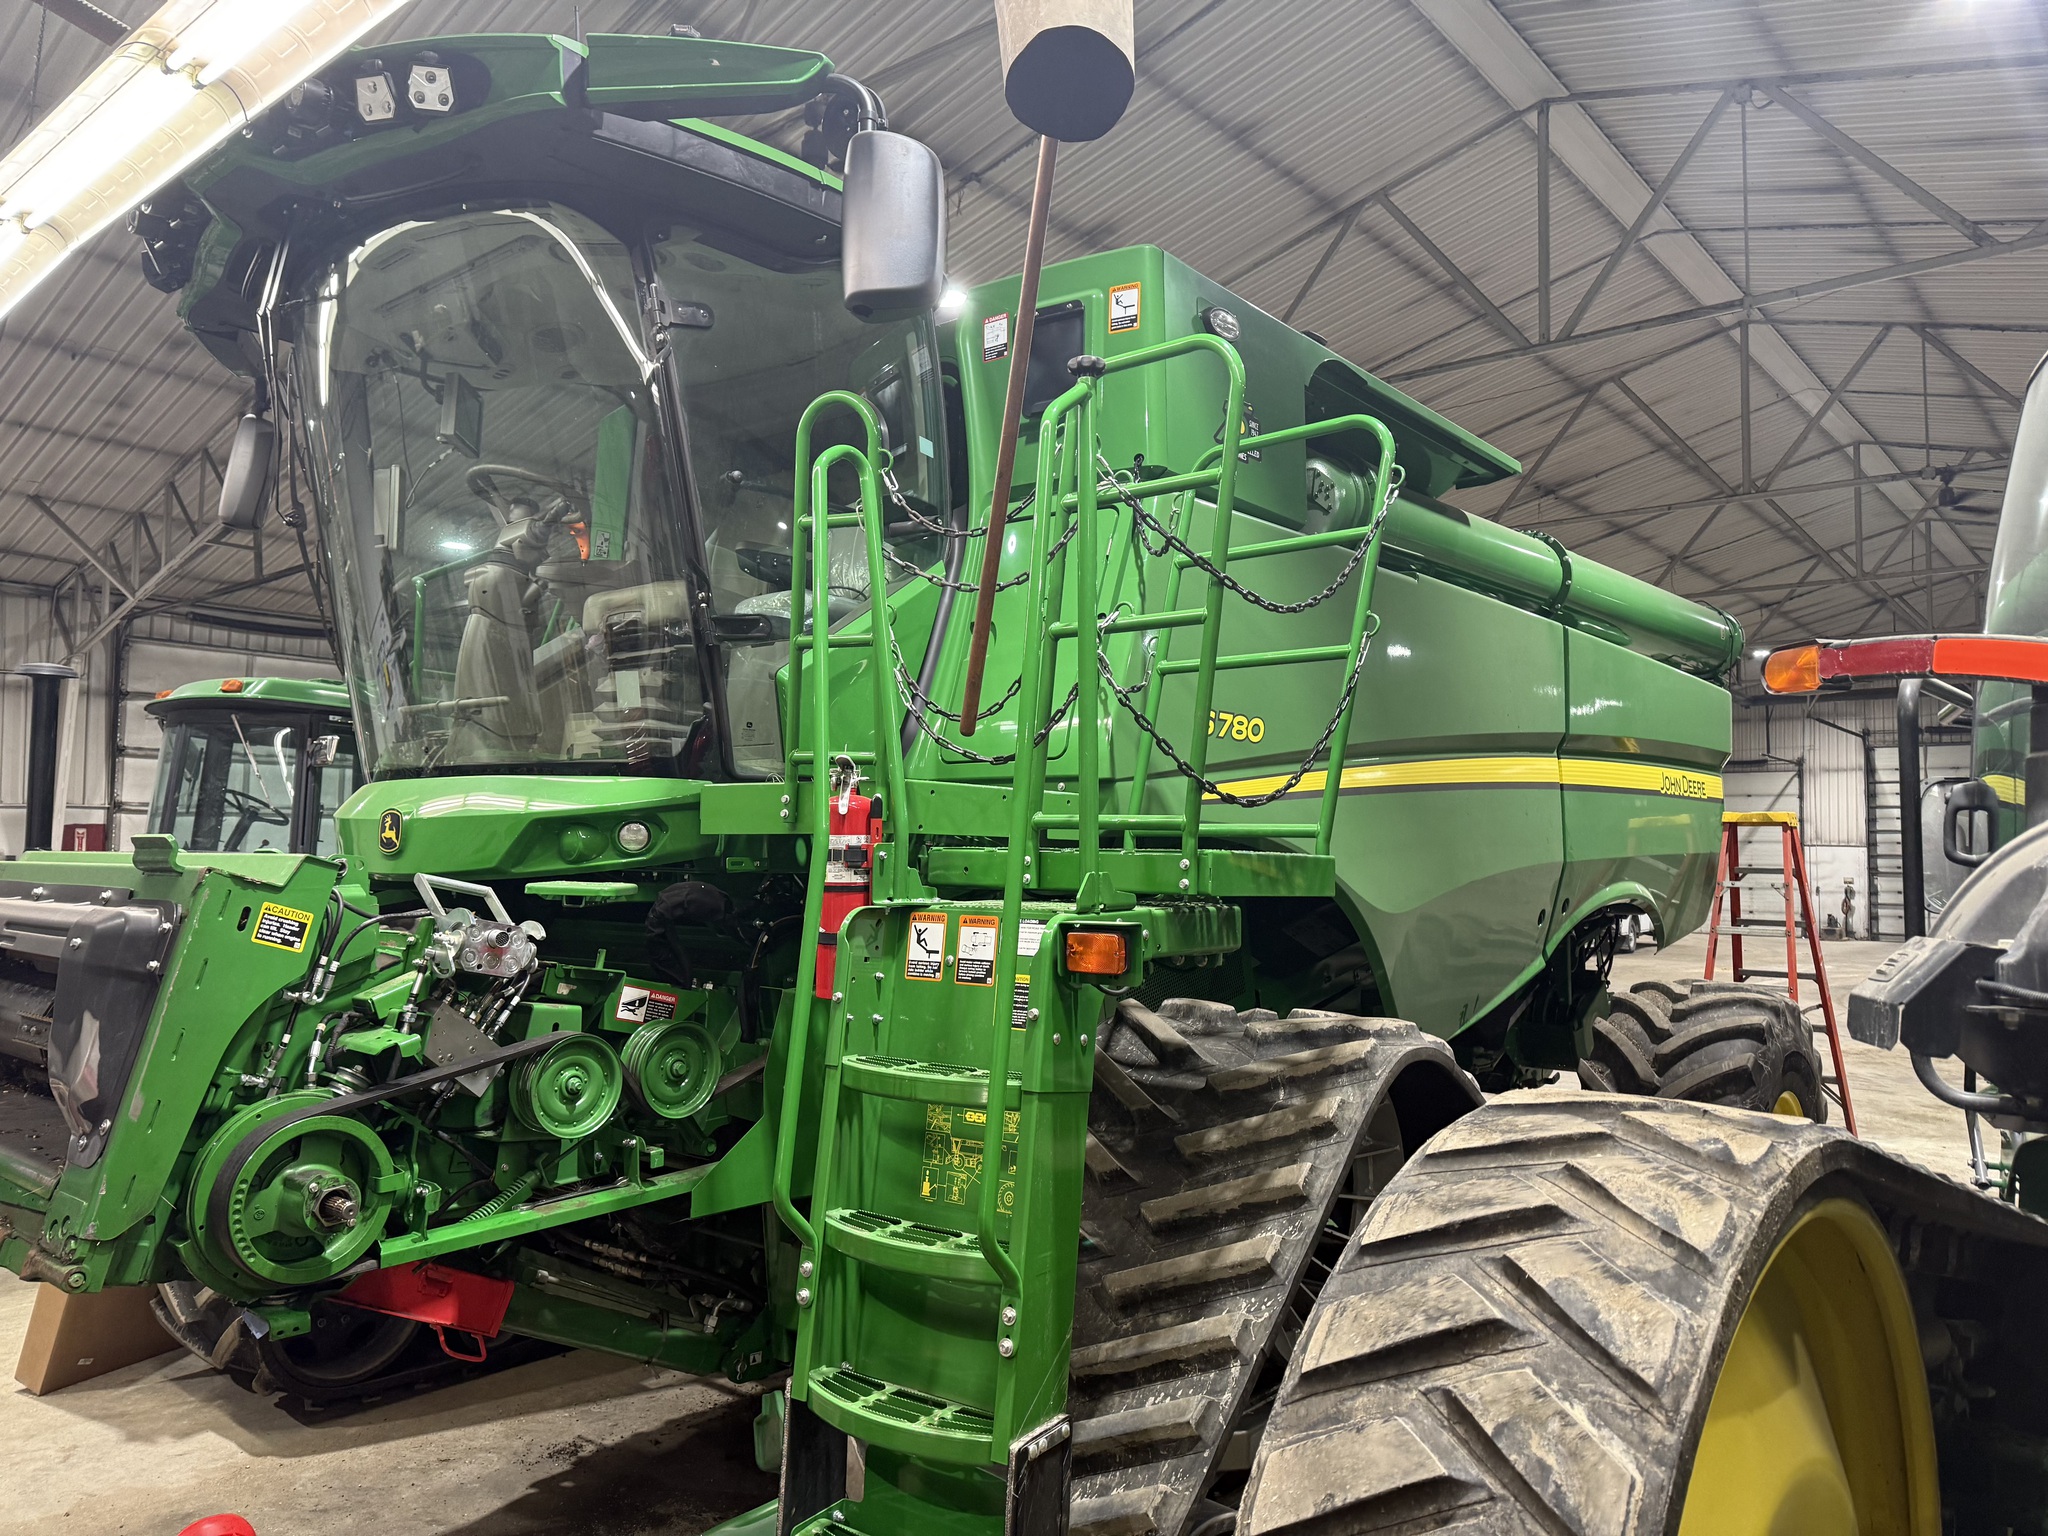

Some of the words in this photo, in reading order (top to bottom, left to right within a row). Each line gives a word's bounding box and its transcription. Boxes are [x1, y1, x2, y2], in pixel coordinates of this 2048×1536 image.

[1117, 283, 1139, 291] WARNING
[989, 313, 1007, 323] DANGER
[1660, 772, 1681, 793] JOHN
[1682, 775, 1706, 796] DEERE
[271, 905, 311, 921] CAUTION
[917, 914, 946, 923] WARNING
[656, 993, 676, 1002] DANGER
